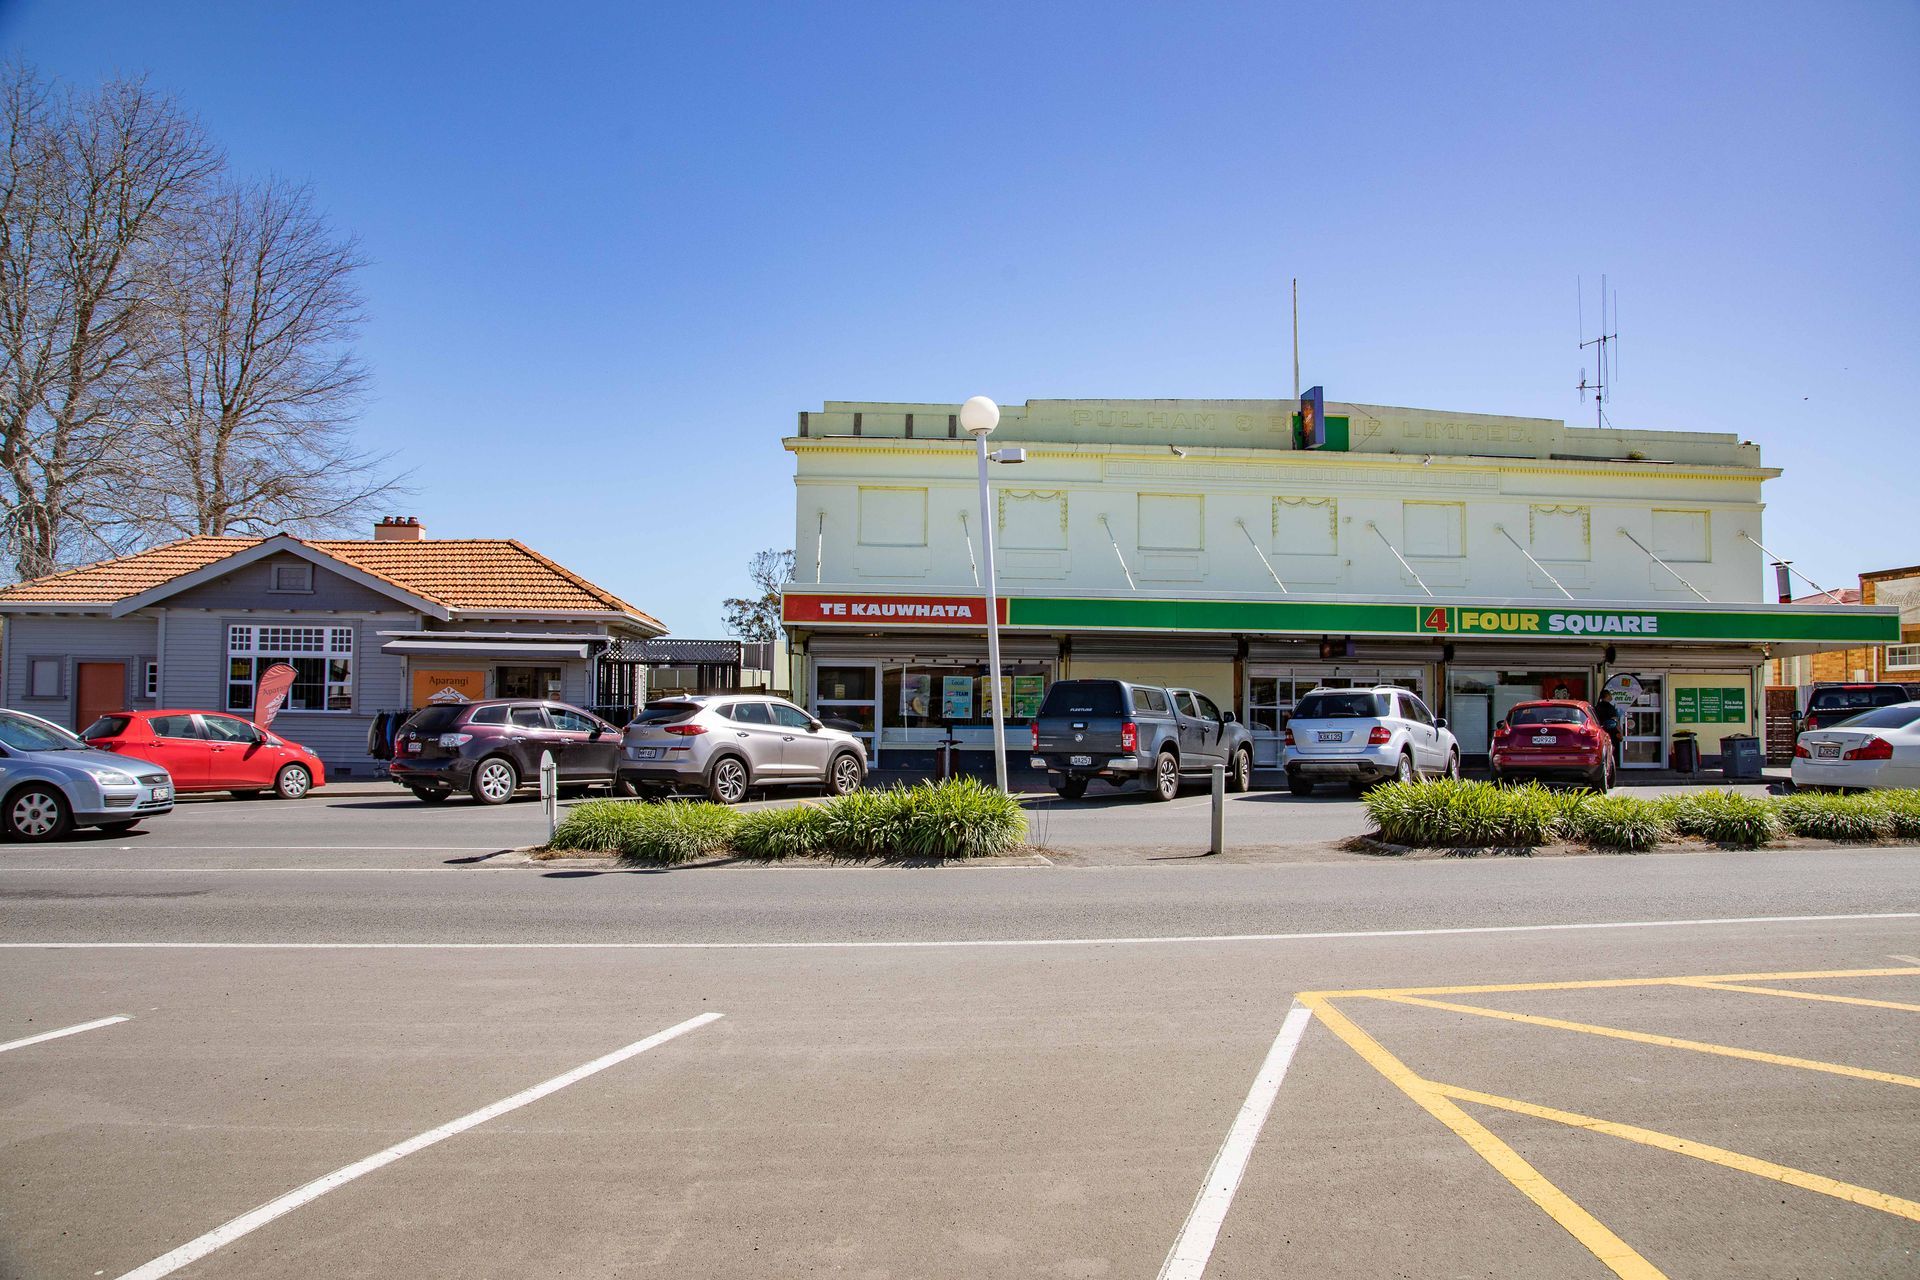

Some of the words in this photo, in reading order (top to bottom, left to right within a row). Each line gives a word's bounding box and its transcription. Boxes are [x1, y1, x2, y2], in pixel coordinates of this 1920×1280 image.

[1073, 409, 1216, 432] PULHAM
[820, 602, 847, 616] TE
[851, 603, 973, 618] KAUWHATA
[1424, 607, 1450, 633] 4
[1461, 612, 1540, 632] FOUR
[1548, 616, 1658, 636] SQUARE
[429, 676, 469, 687] Aparangi
